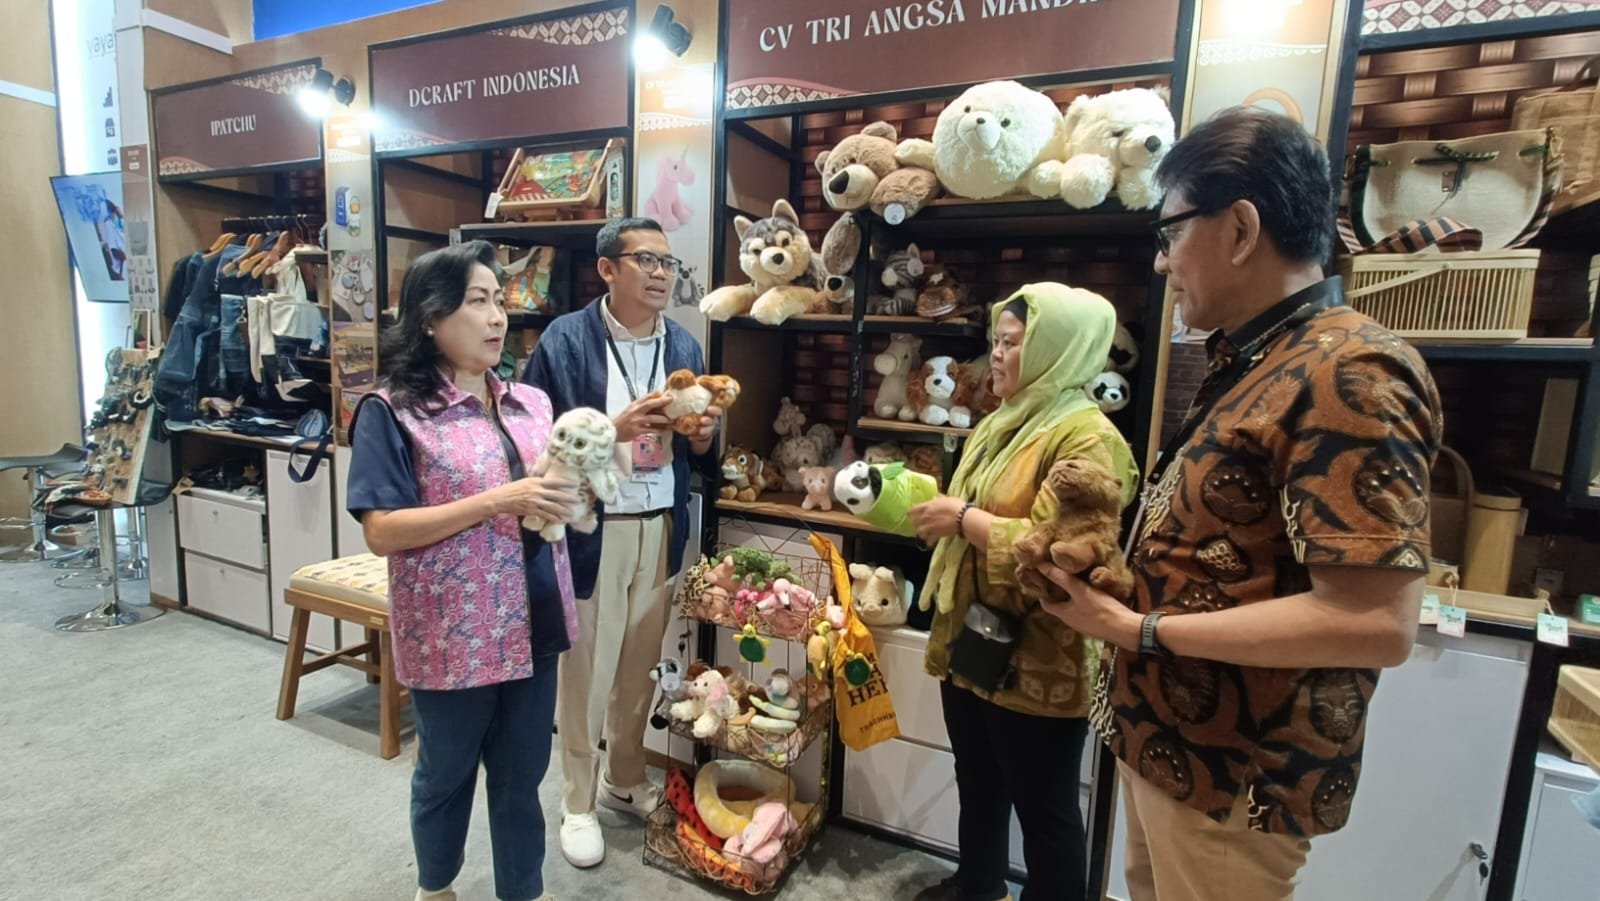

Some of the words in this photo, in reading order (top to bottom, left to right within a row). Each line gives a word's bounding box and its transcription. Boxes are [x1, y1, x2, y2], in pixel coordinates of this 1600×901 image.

[759, 25, 793, 52] CV
[806, 15, 851, 45] TRI
[864, 0, 966, 37] ANGSA
[409, 79, 476, 108] DCRAFT
[483, 63, 580, 97] INDONESIA
[211, 114, 256, 137] IPATCHU
